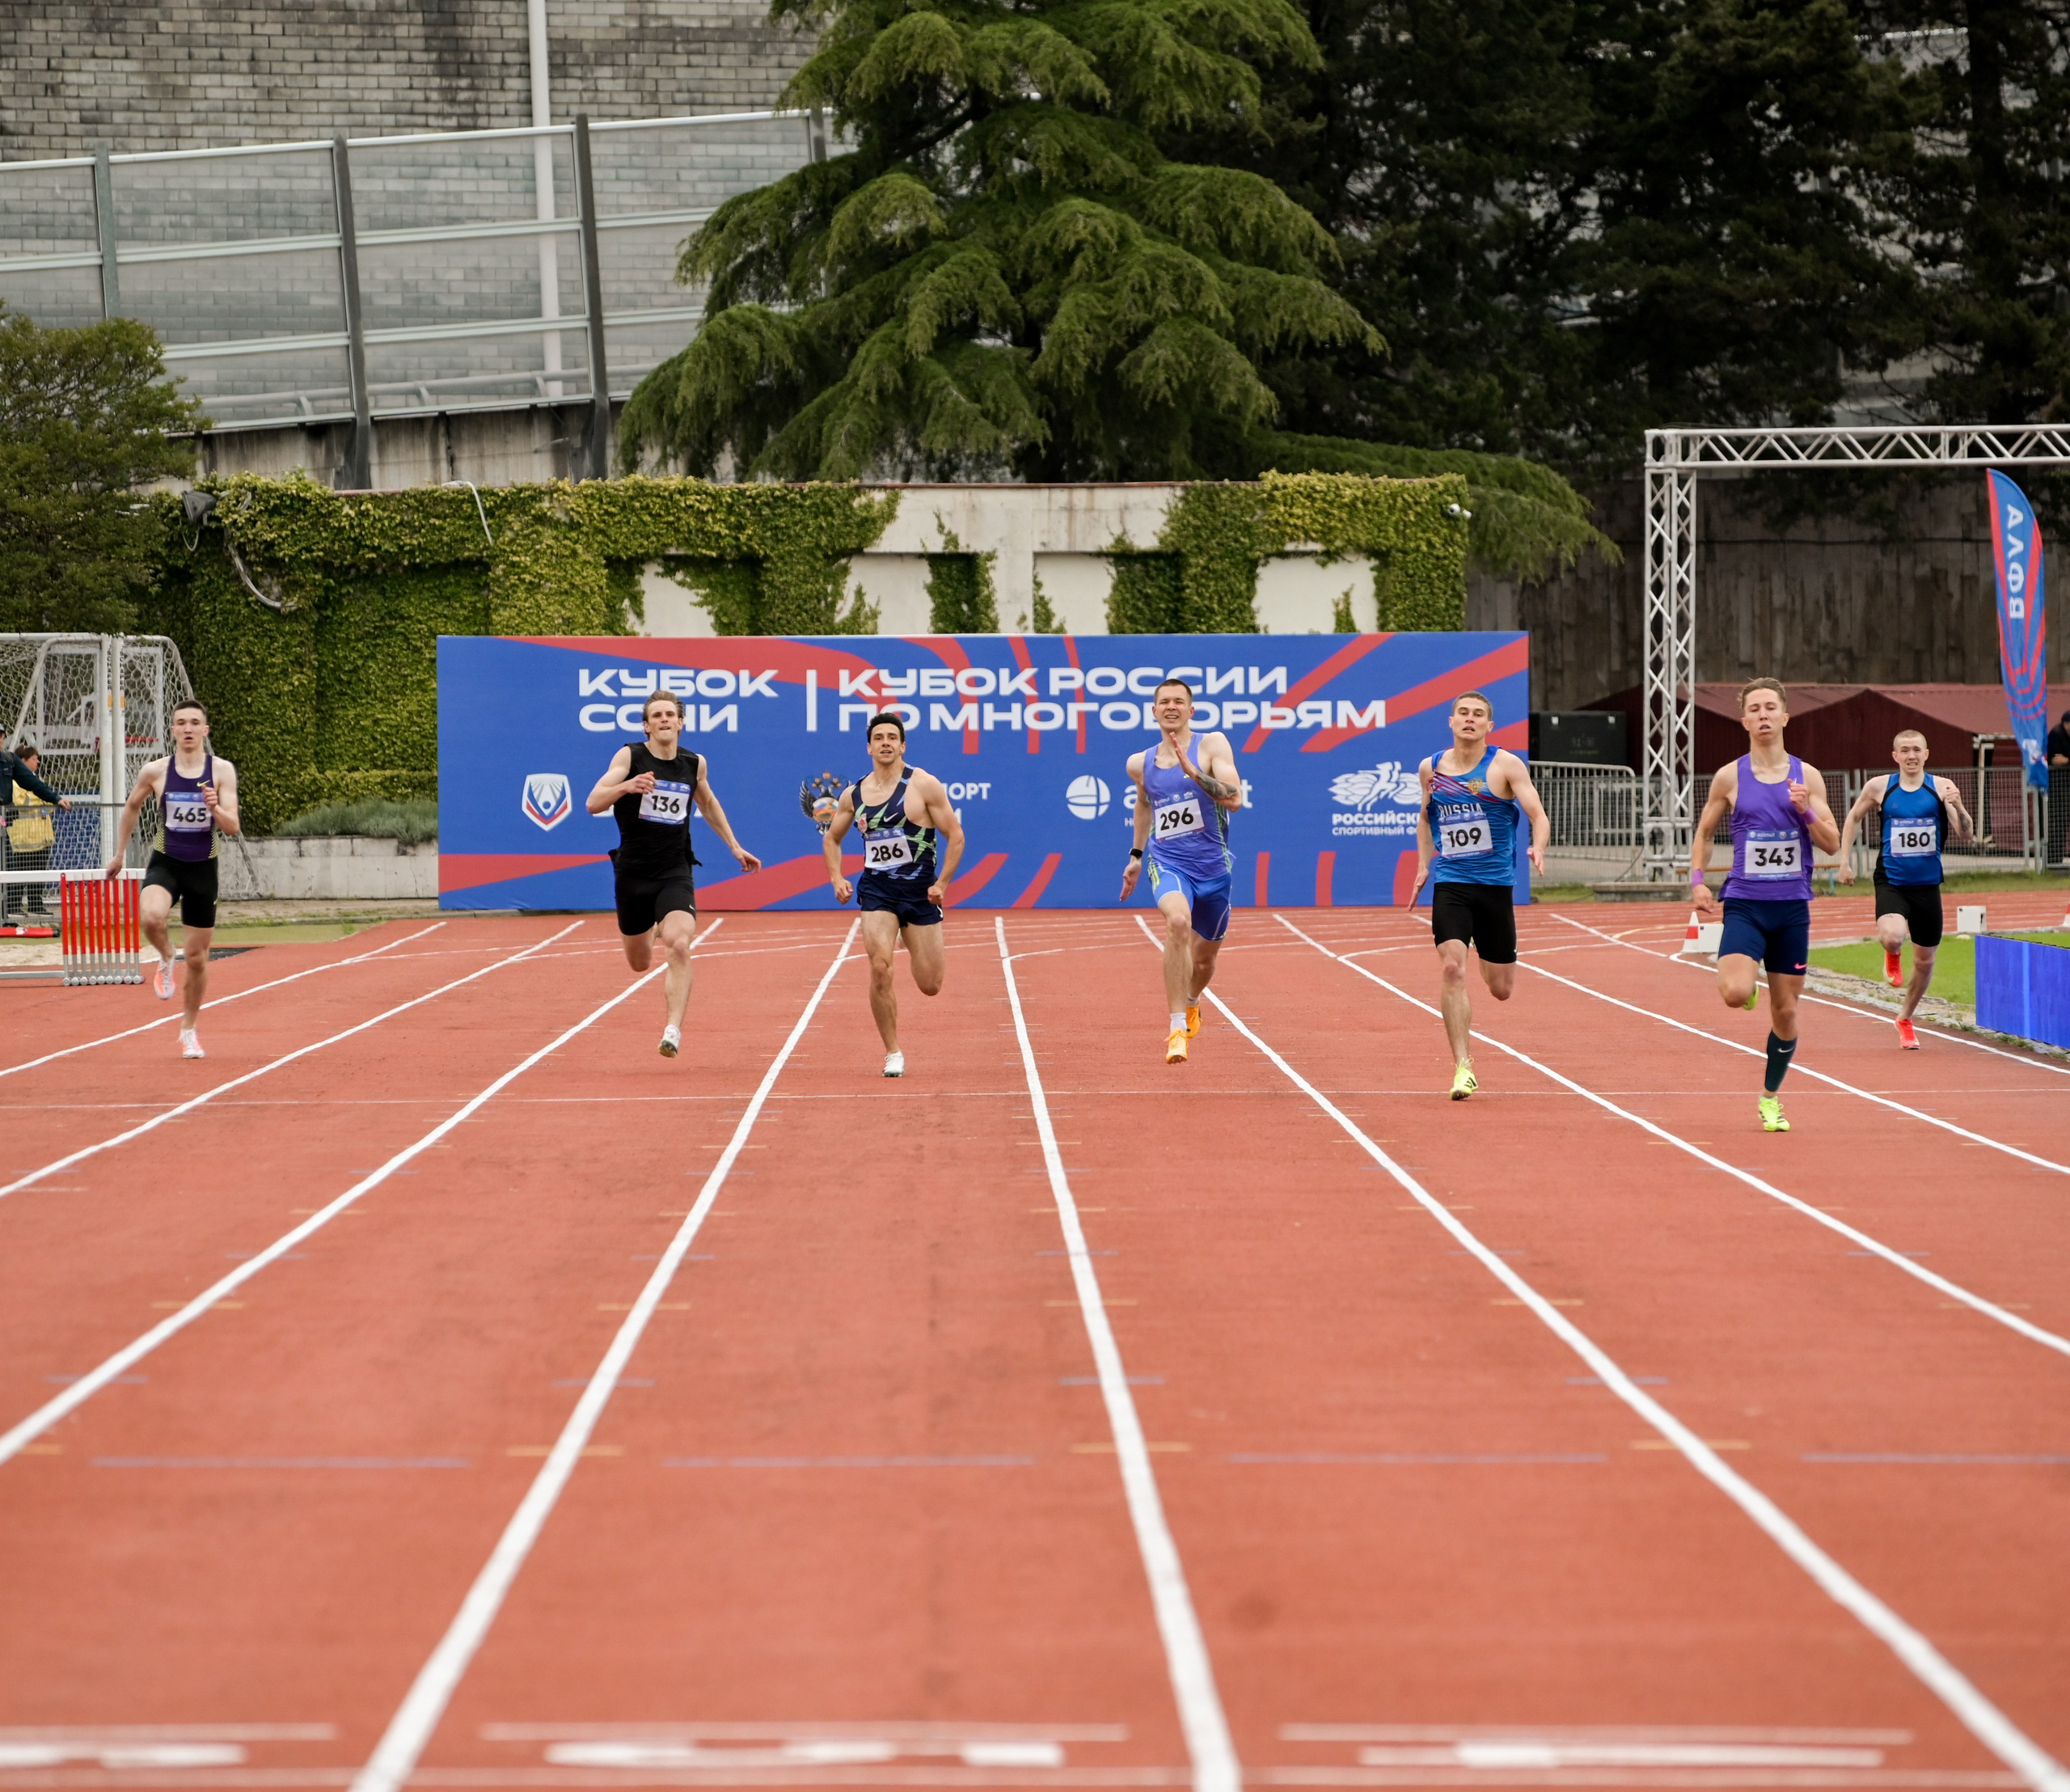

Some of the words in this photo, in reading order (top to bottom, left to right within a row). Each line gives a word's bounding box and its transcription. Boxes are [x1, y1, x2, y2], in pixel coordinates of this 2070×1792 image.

[2007, 503, 2025, 619] ВФЛА
[578, 668, 779, 698] КУБОК
[839, 667, 1039, 697] КУБОК
[1049, 666, 1287, 696] РОССИИ
[839, 703, 920, 732] ПО
[172, 806, 207, 823] 465
[651, 795, 680, 814] 136
[1438, 802, 1483, 818] RUSSIA
[1160, 807, 1194, 831] 296
[1332, 825, 1405, 836] СПОРТИВНЫЙ
[1447, 826, 1482, 848] 109
[1898, 831, 1931, 847] 180
[871, 843, 904, 863] 286
[1754, 847, 1795, 867] 343
